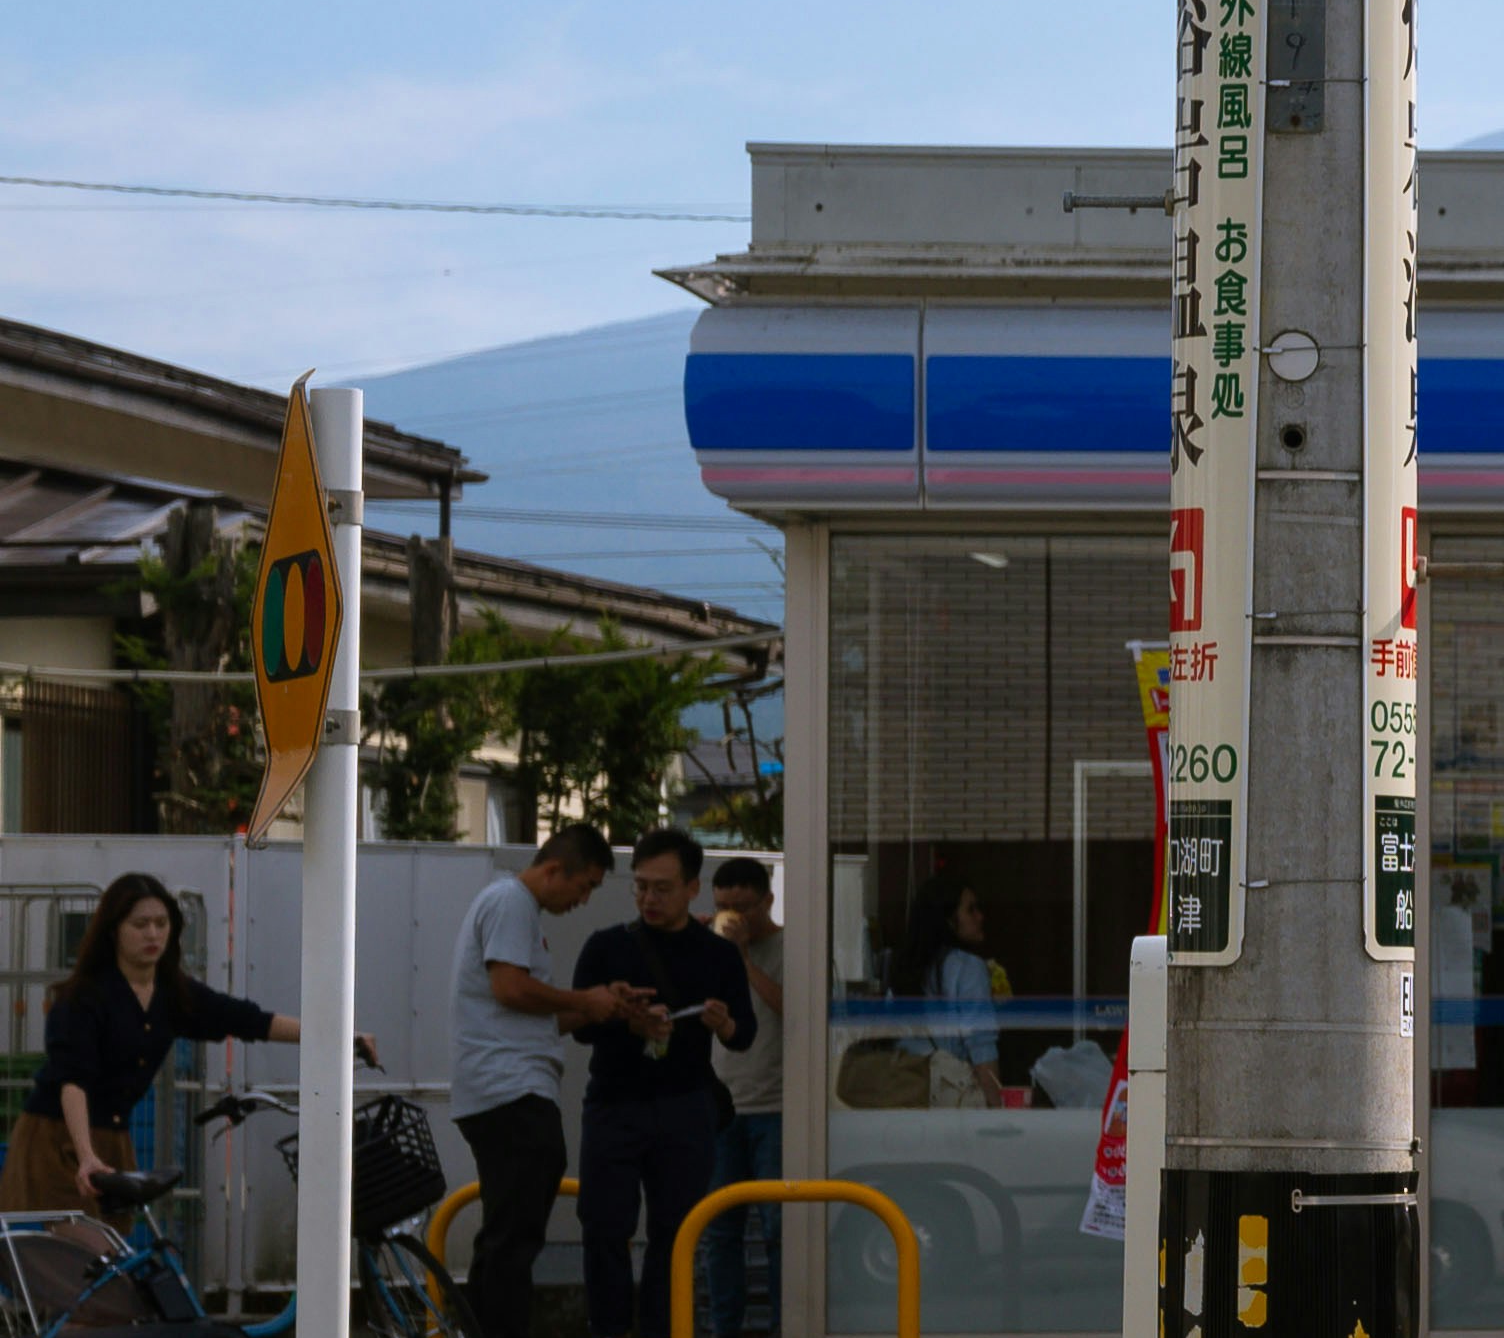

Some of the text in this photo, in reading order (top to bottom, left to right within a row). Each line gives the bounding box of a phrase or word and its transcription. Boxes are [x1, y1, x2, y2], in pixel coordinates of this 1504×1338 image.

[1211, 217, 1249, 420] お食事処
[1170, 641, 1218, 682] 左折
